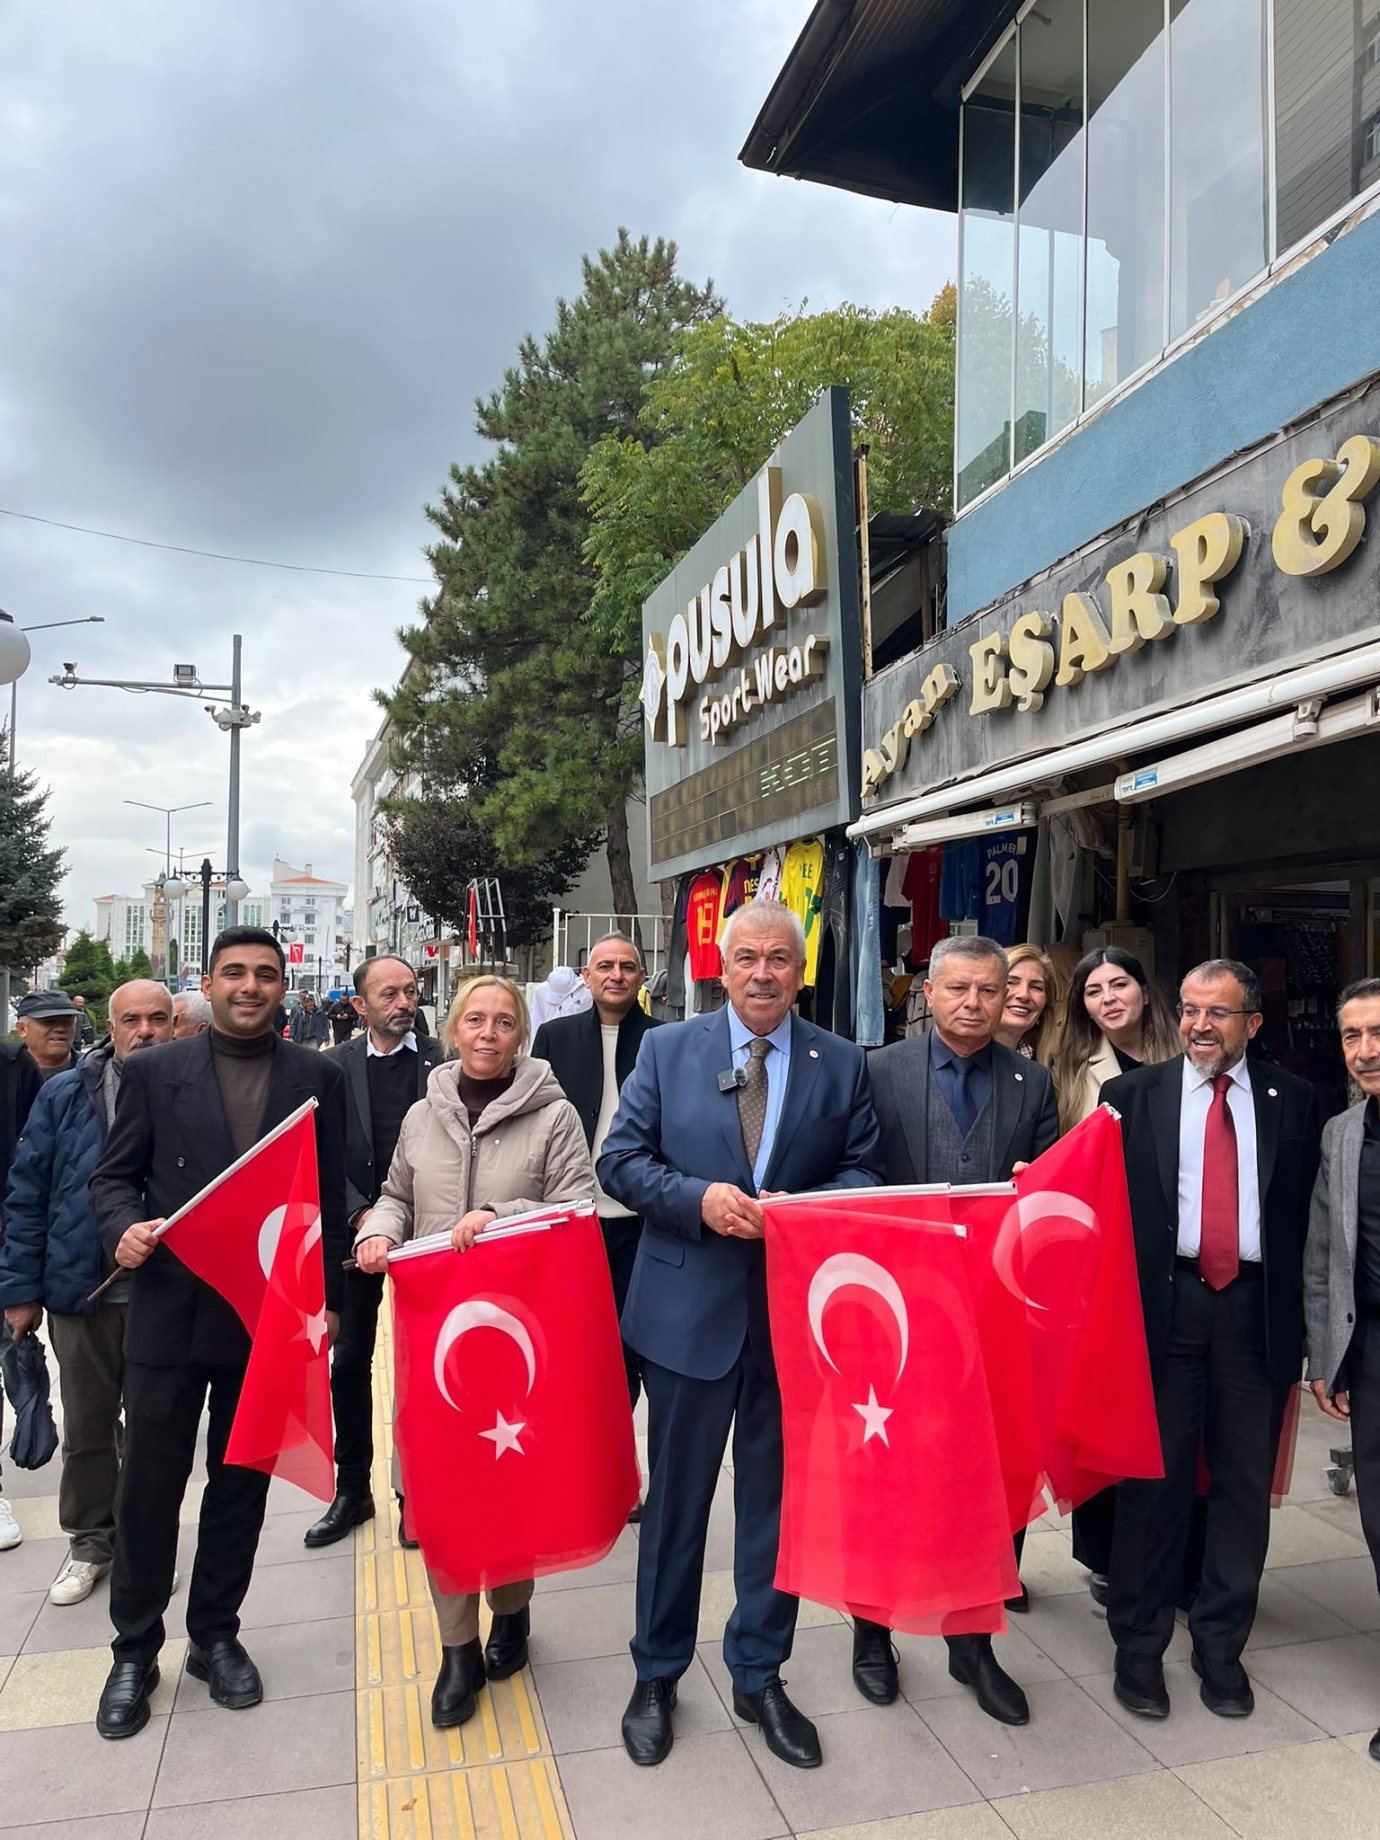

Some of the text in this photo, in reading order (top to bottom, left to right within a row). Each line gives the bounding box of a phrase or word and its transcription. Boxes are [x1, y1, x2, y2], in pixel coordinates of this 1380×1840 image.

[860, 434, 1380, 798] Ayan EŞARP &
[699, 634, 822, 746] Sport Wear
[985, 858, 1019, 905] 20
